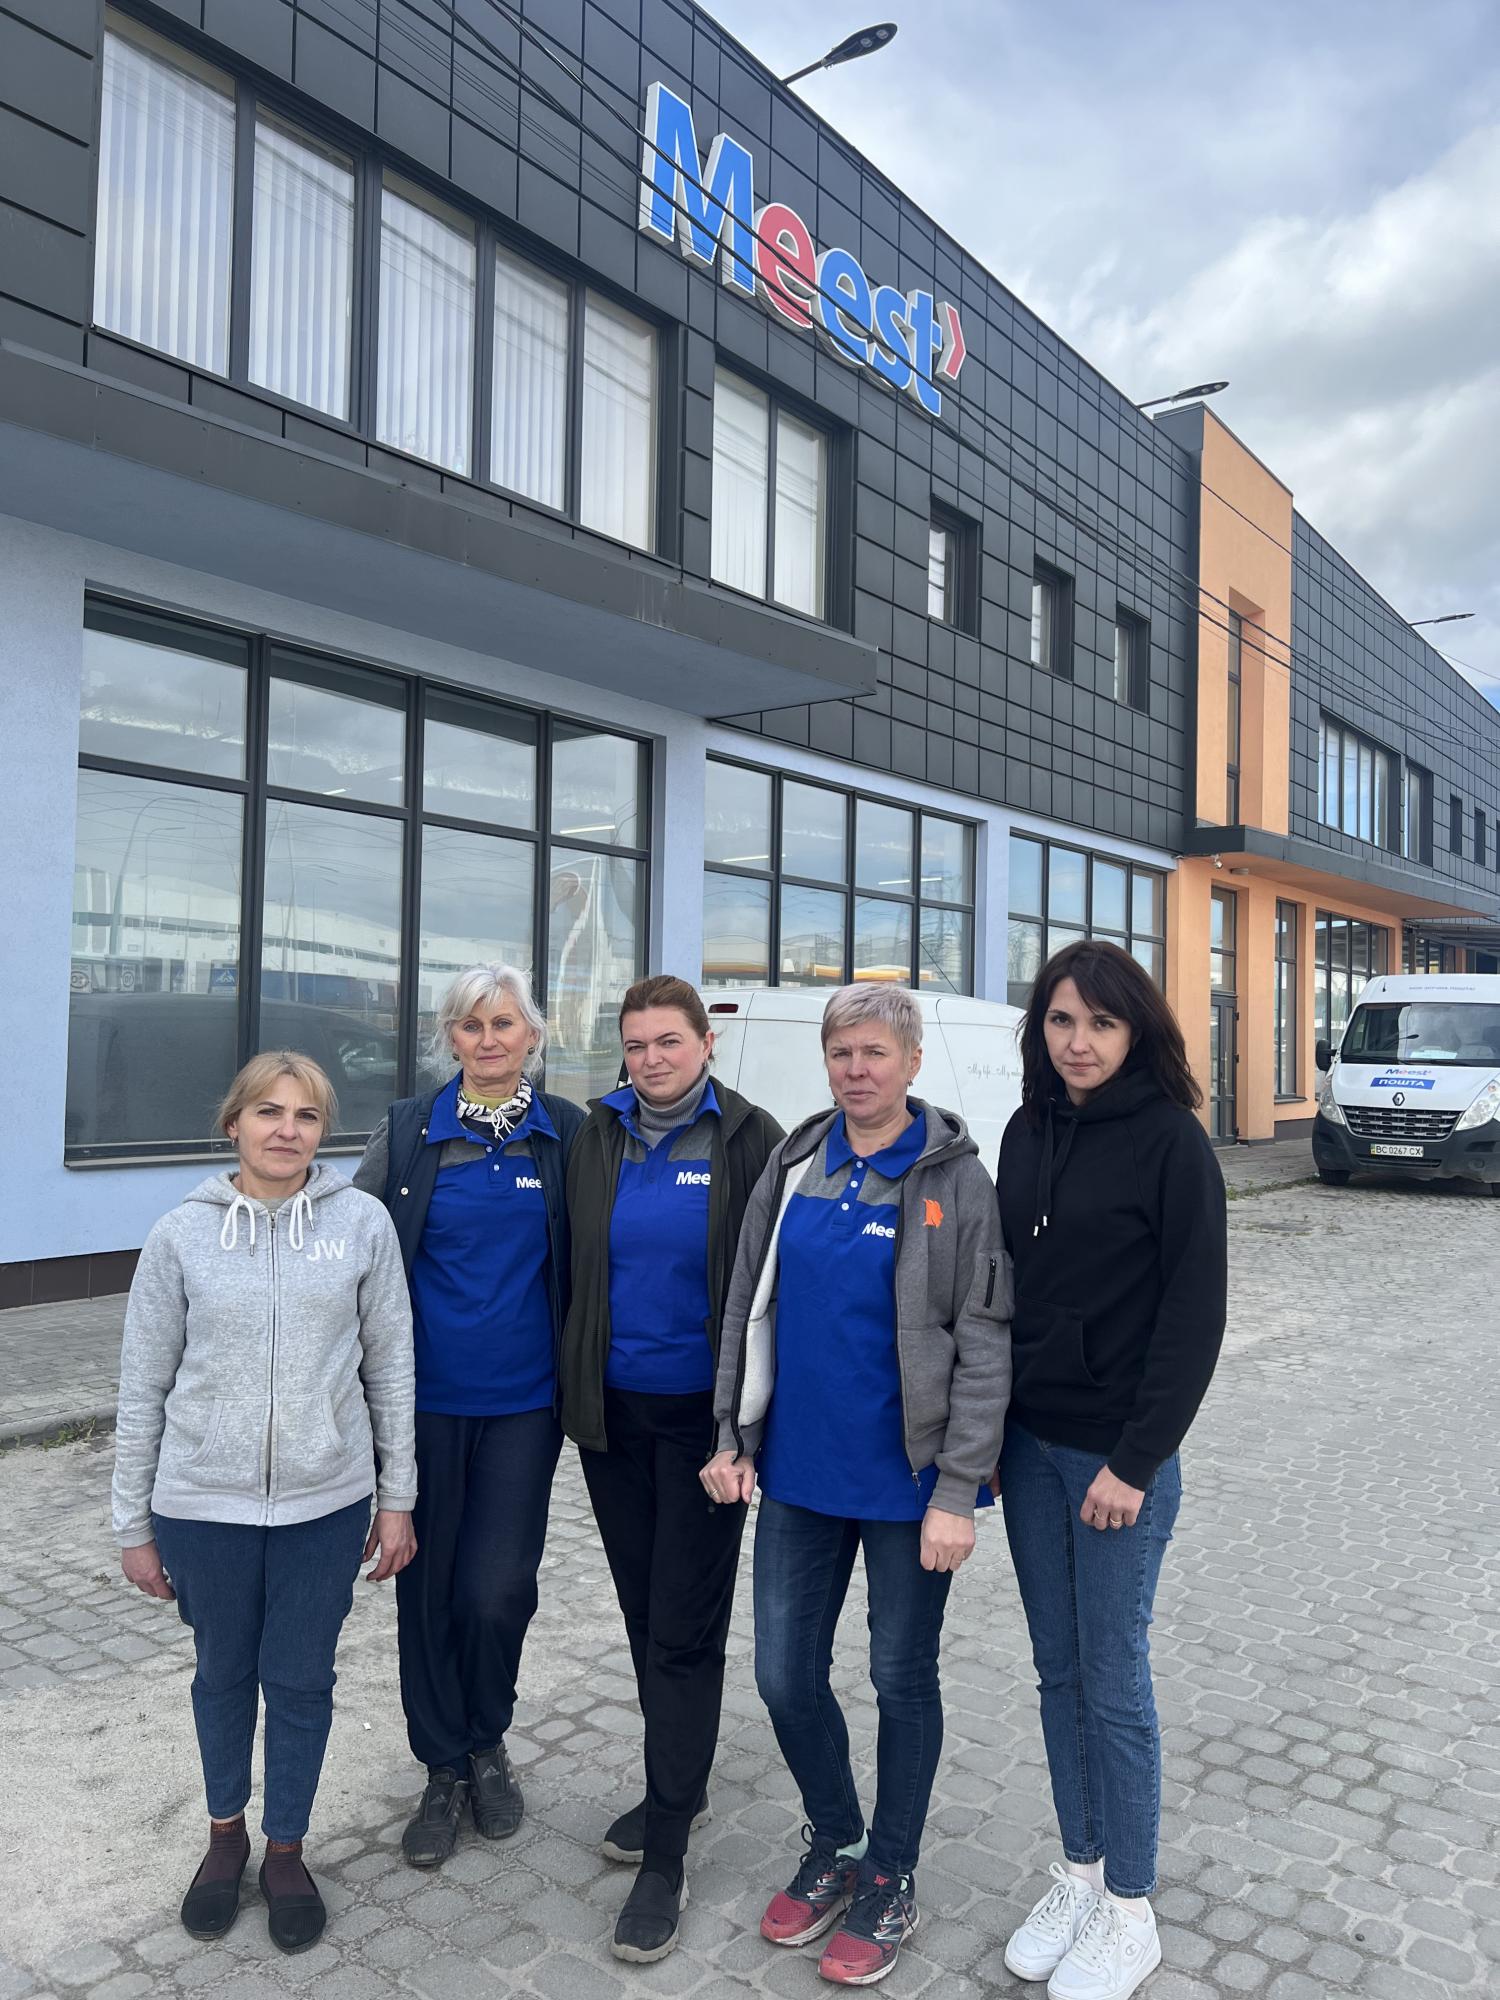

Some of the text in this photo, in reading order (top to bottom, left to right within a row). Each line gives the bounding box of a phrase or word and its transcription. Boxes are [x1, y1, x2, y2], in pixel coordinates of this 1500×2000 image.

[641, 81, 942, 417] Meest
[1385, 1068, 1429, 1076] Meest
[1378, 1078, 1425, 1087] ПОШТА
[1388, 1146, 1408, 1155] 0267
[515, 1176, 542, 1189] Mee
[675, 1170, 711, 1186] Mee
[861, 1221, 896, 1239] Mee
[306, 1239, 346, 1261] JW
